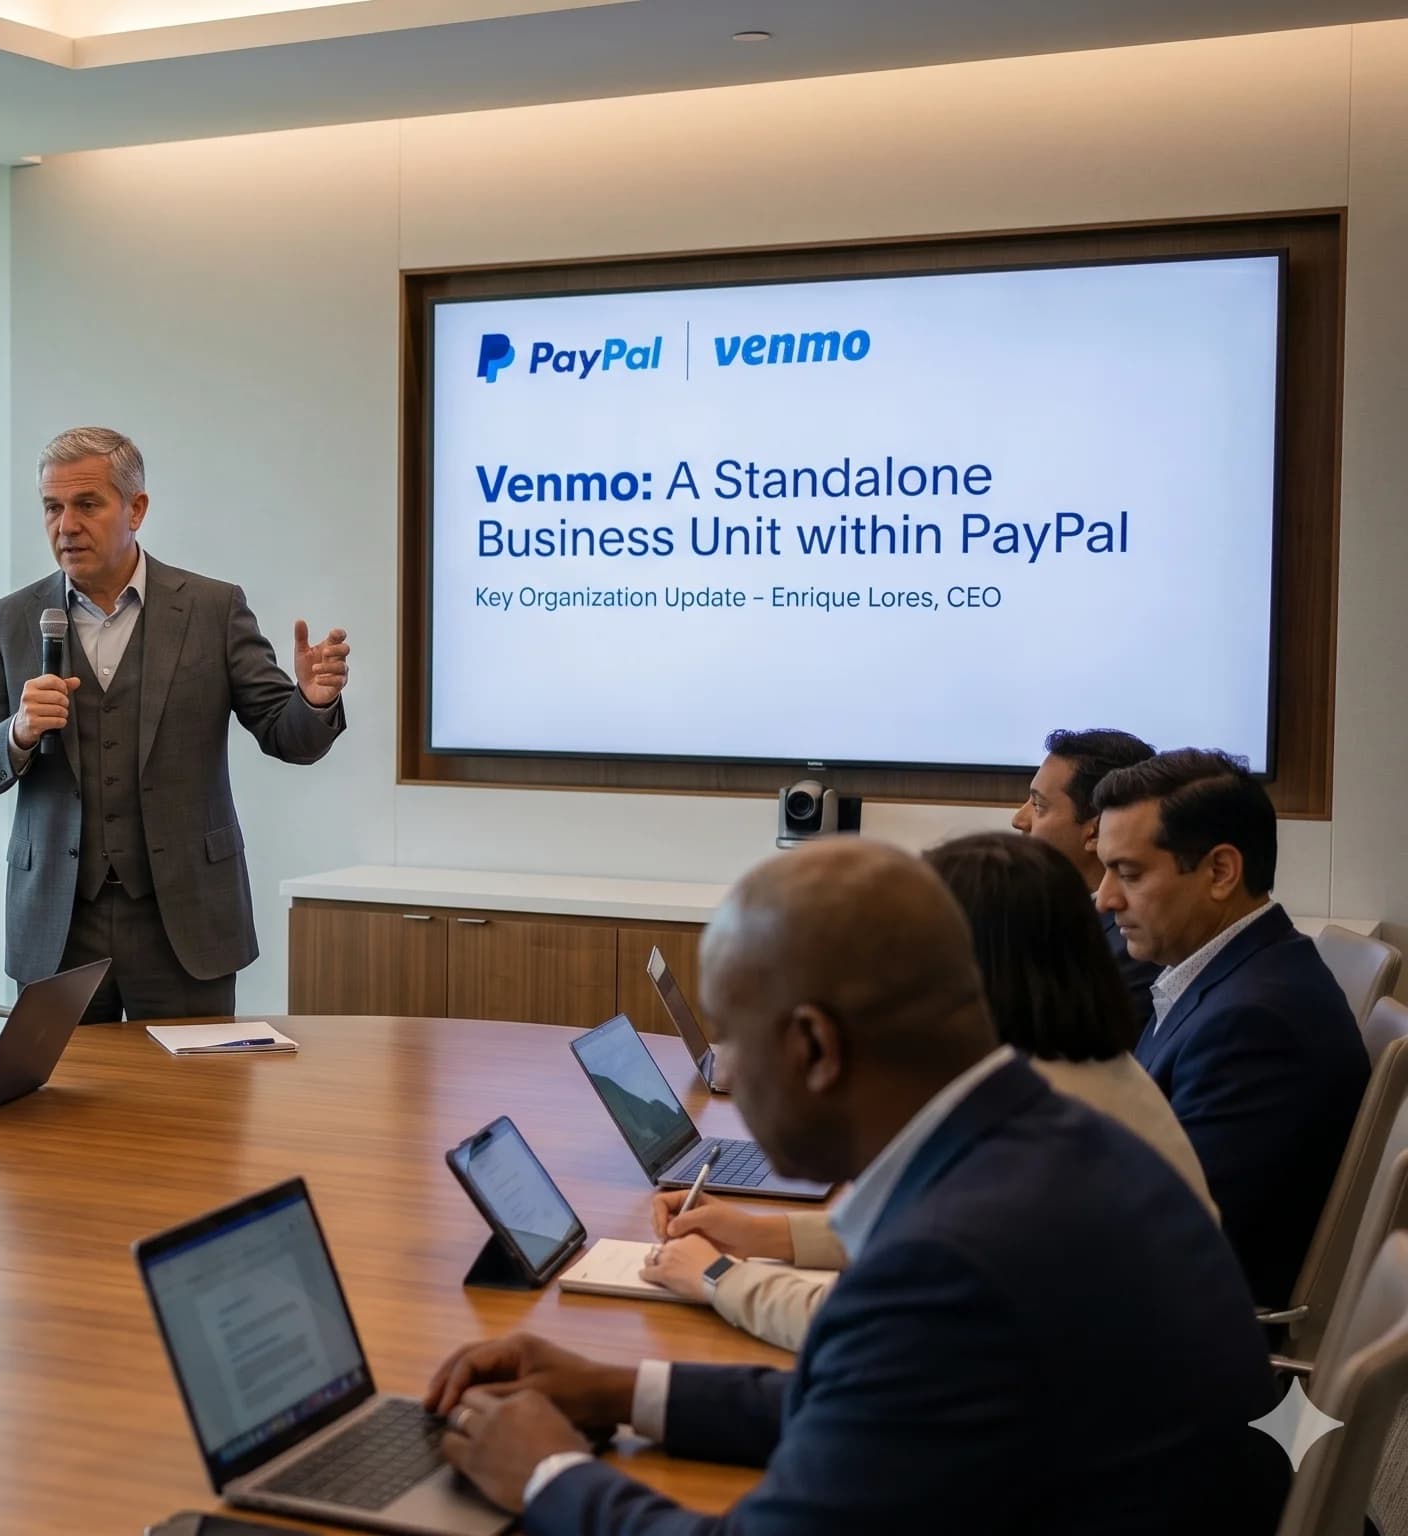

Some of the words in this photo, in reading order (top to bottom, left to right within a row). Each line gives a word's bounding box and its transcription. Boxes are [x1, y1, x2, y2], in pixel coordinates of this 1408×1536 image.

[528, 336, 664, 380] PayPal
[714, 328, 872, 368] venmo
[475, 465, 653, 504] Venmo:
[665, 460, 701, 501] A
[714, 456, 993, 500] Standalone
[476, 518, 675, 559] Business
[690, 515, 782, 557] Unit
[795, 513, 942, 556] within
[961, 510, 1128, 565] PayPal
[475, 586, 514, 613] Key
[518, 585, 658, 613] Organization
[665, 586, 747, 613] Update
[771, 585, 861, 614] Enrique
[868, 586, 940, 612] Lores,
[946, 585, 1002, 609] CEO
